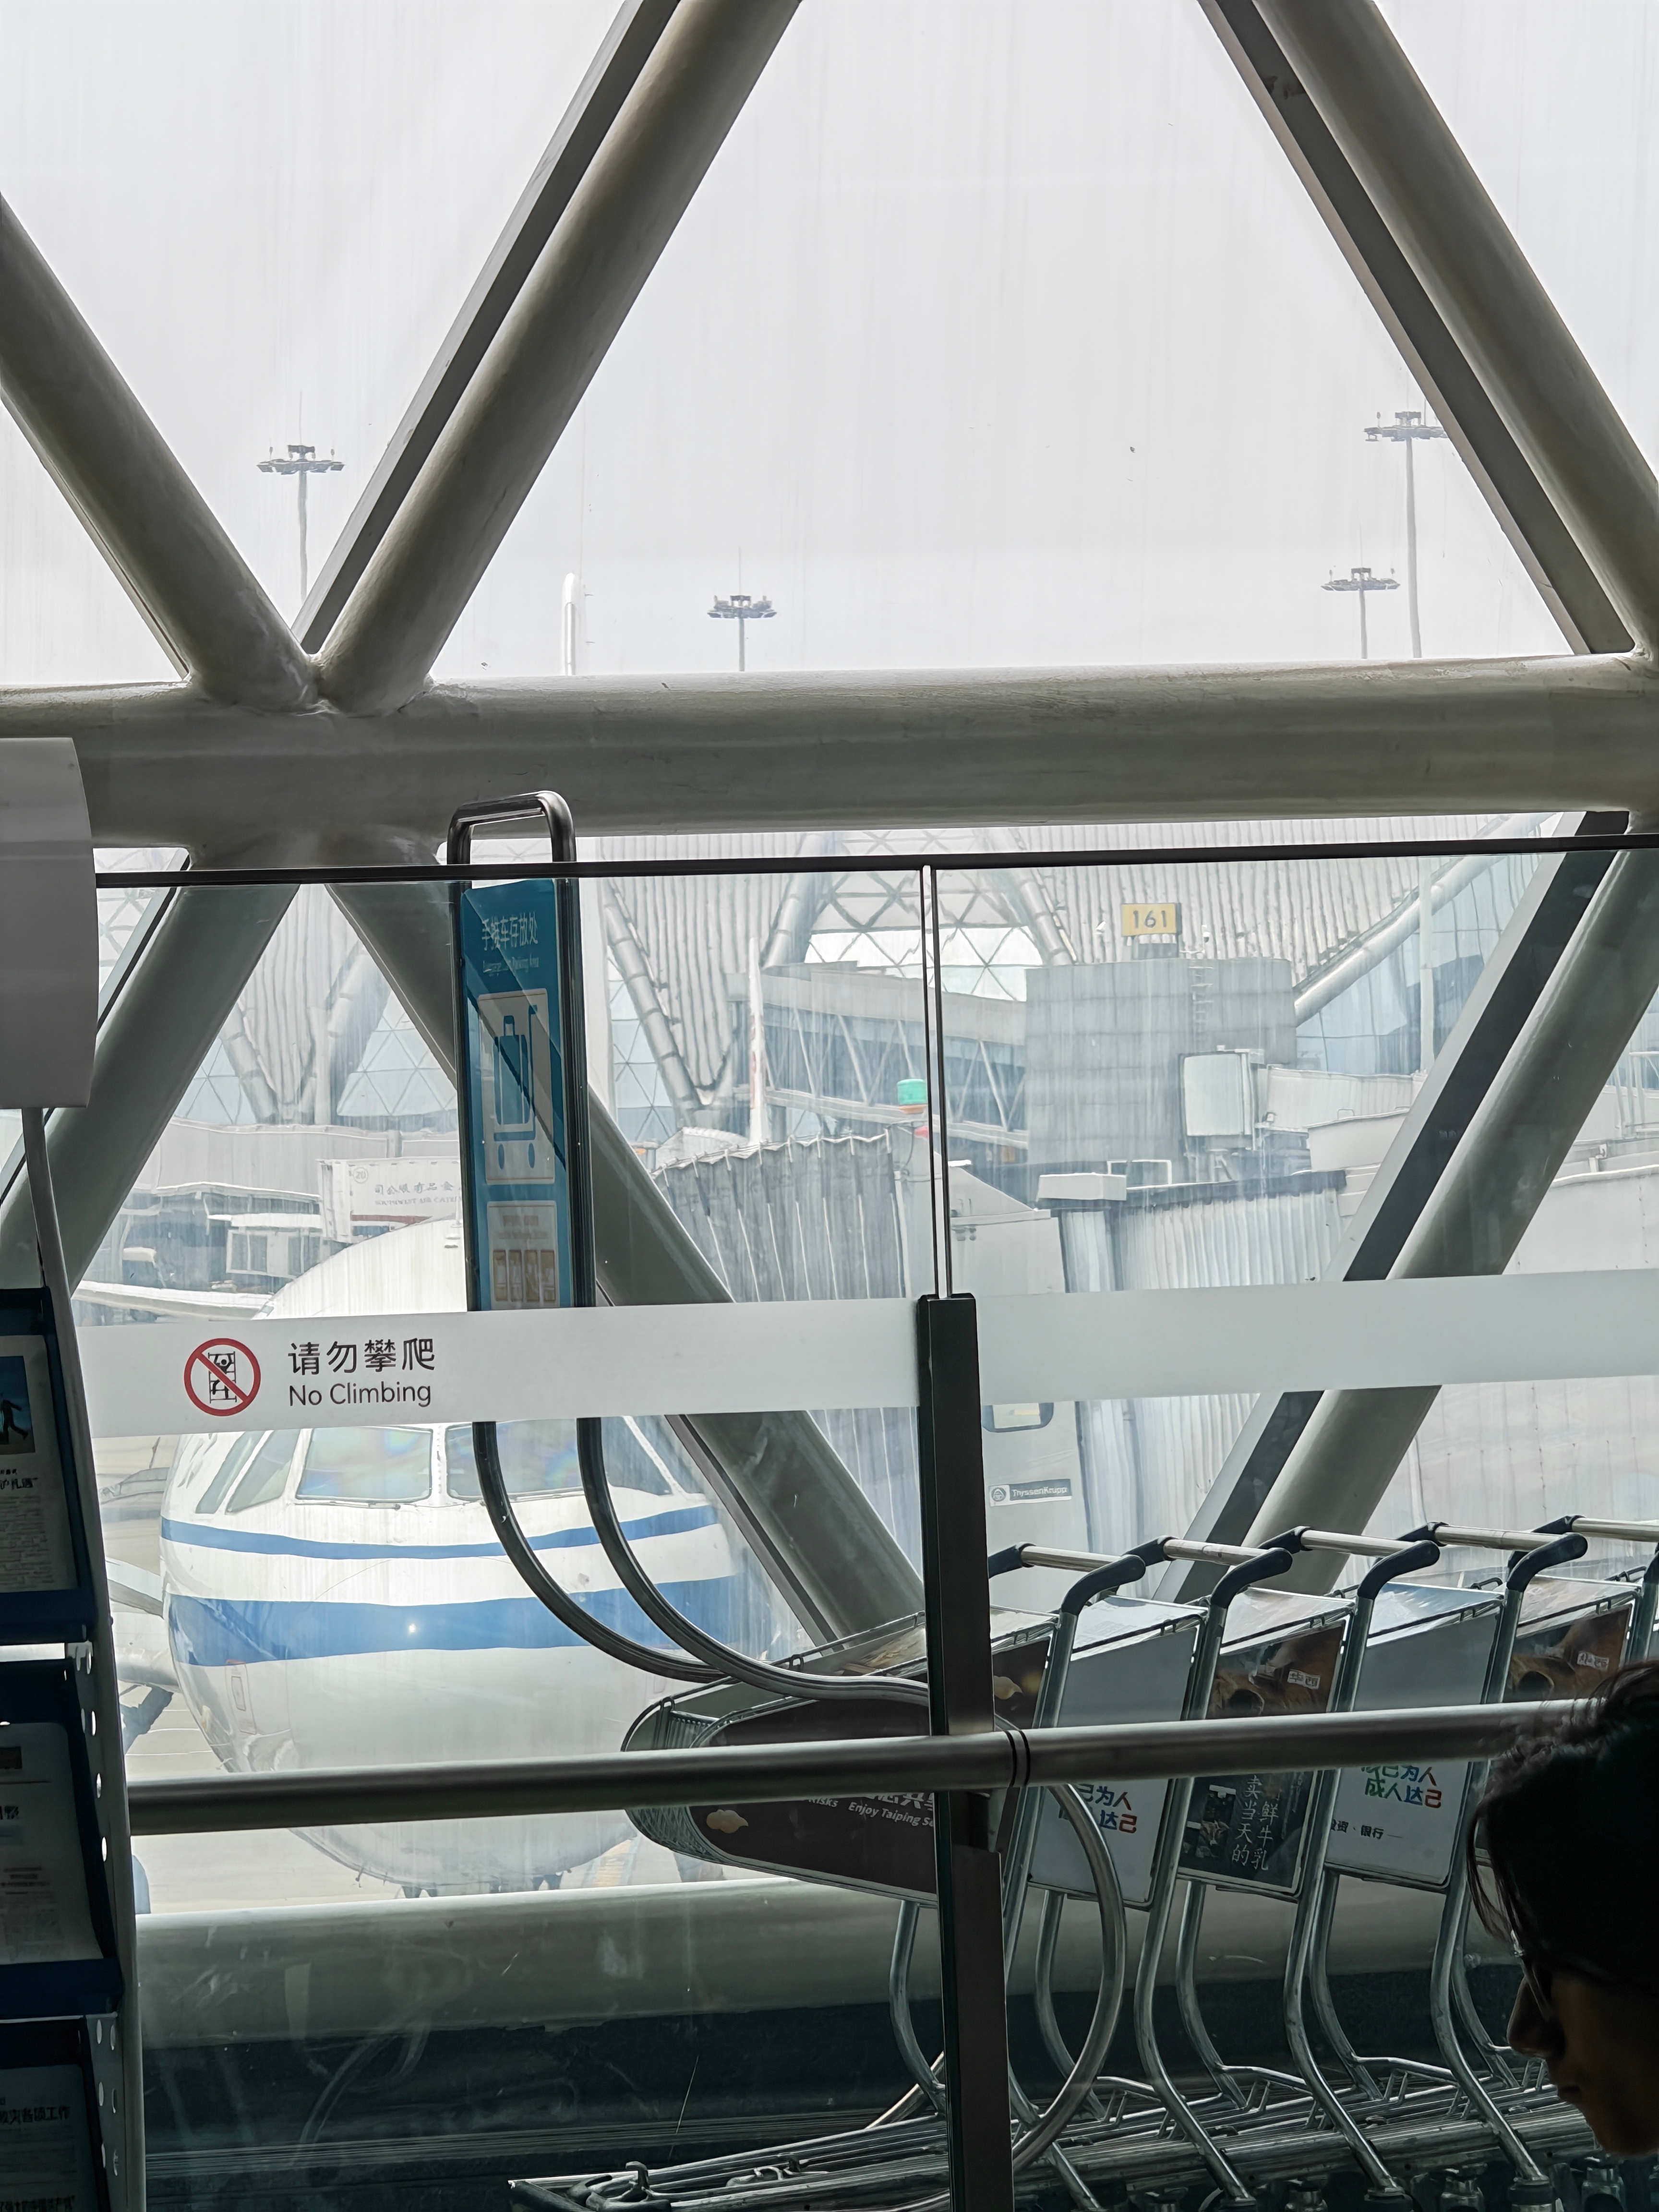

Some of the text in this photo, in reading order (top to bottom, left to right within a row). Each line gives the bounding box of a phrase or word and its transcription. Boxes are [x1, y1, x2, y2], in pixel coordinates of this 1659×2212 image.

[1133, 910, 1167, 929] 161
[288, 1337, 435, 1375] 请勿攀爬
[289, 1381, 431, 1407] No Climbing
[1365, 1778, 1442, 1808] 成人达己
[848, 1802, 879, 1818] Enjoy
[881, 1808, 921, 1827] Taiping
[1251, 1789, 1282, 1871] 鲜牛乳
